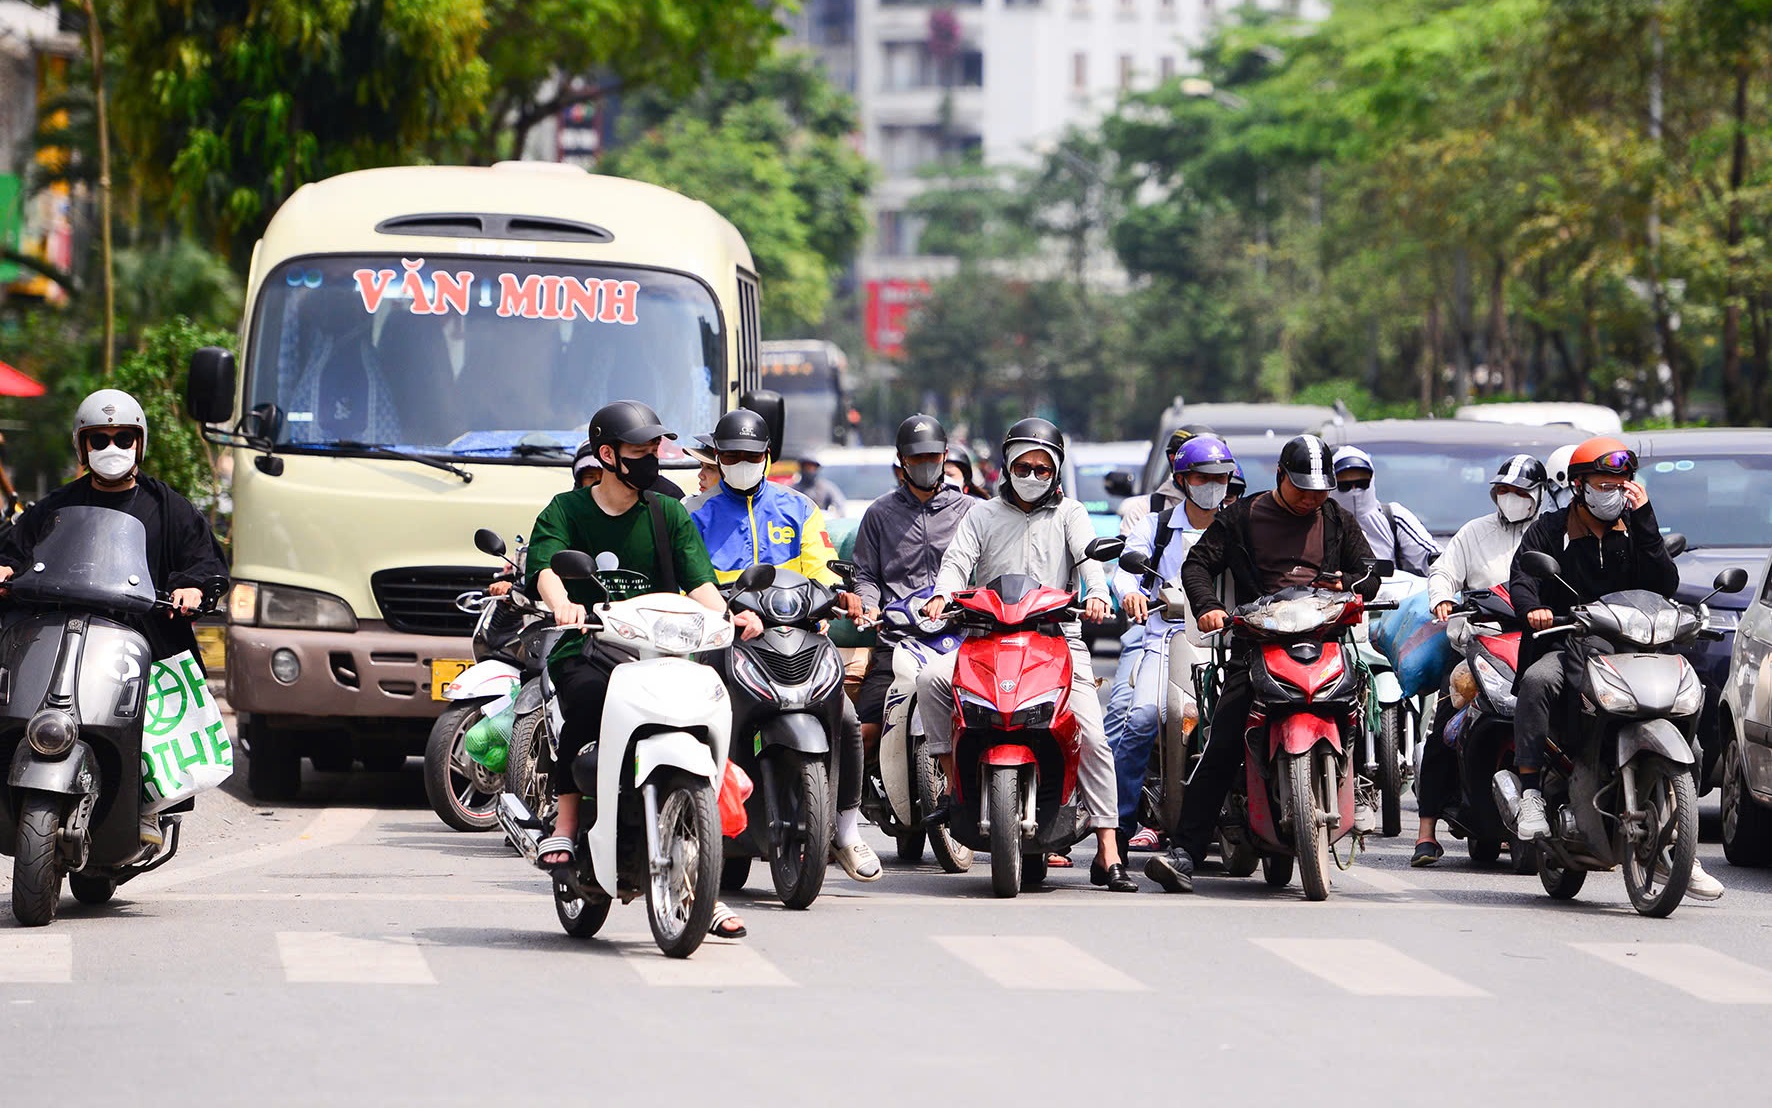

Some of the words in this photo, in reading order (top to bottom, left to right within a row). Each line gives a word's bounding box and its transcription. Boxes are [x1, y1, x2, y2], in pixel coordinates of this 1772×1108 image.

[354, 258, 474, 315] VĂN
[498, 273, 640, 324] MINH
[768, 521, 795, 544] be
